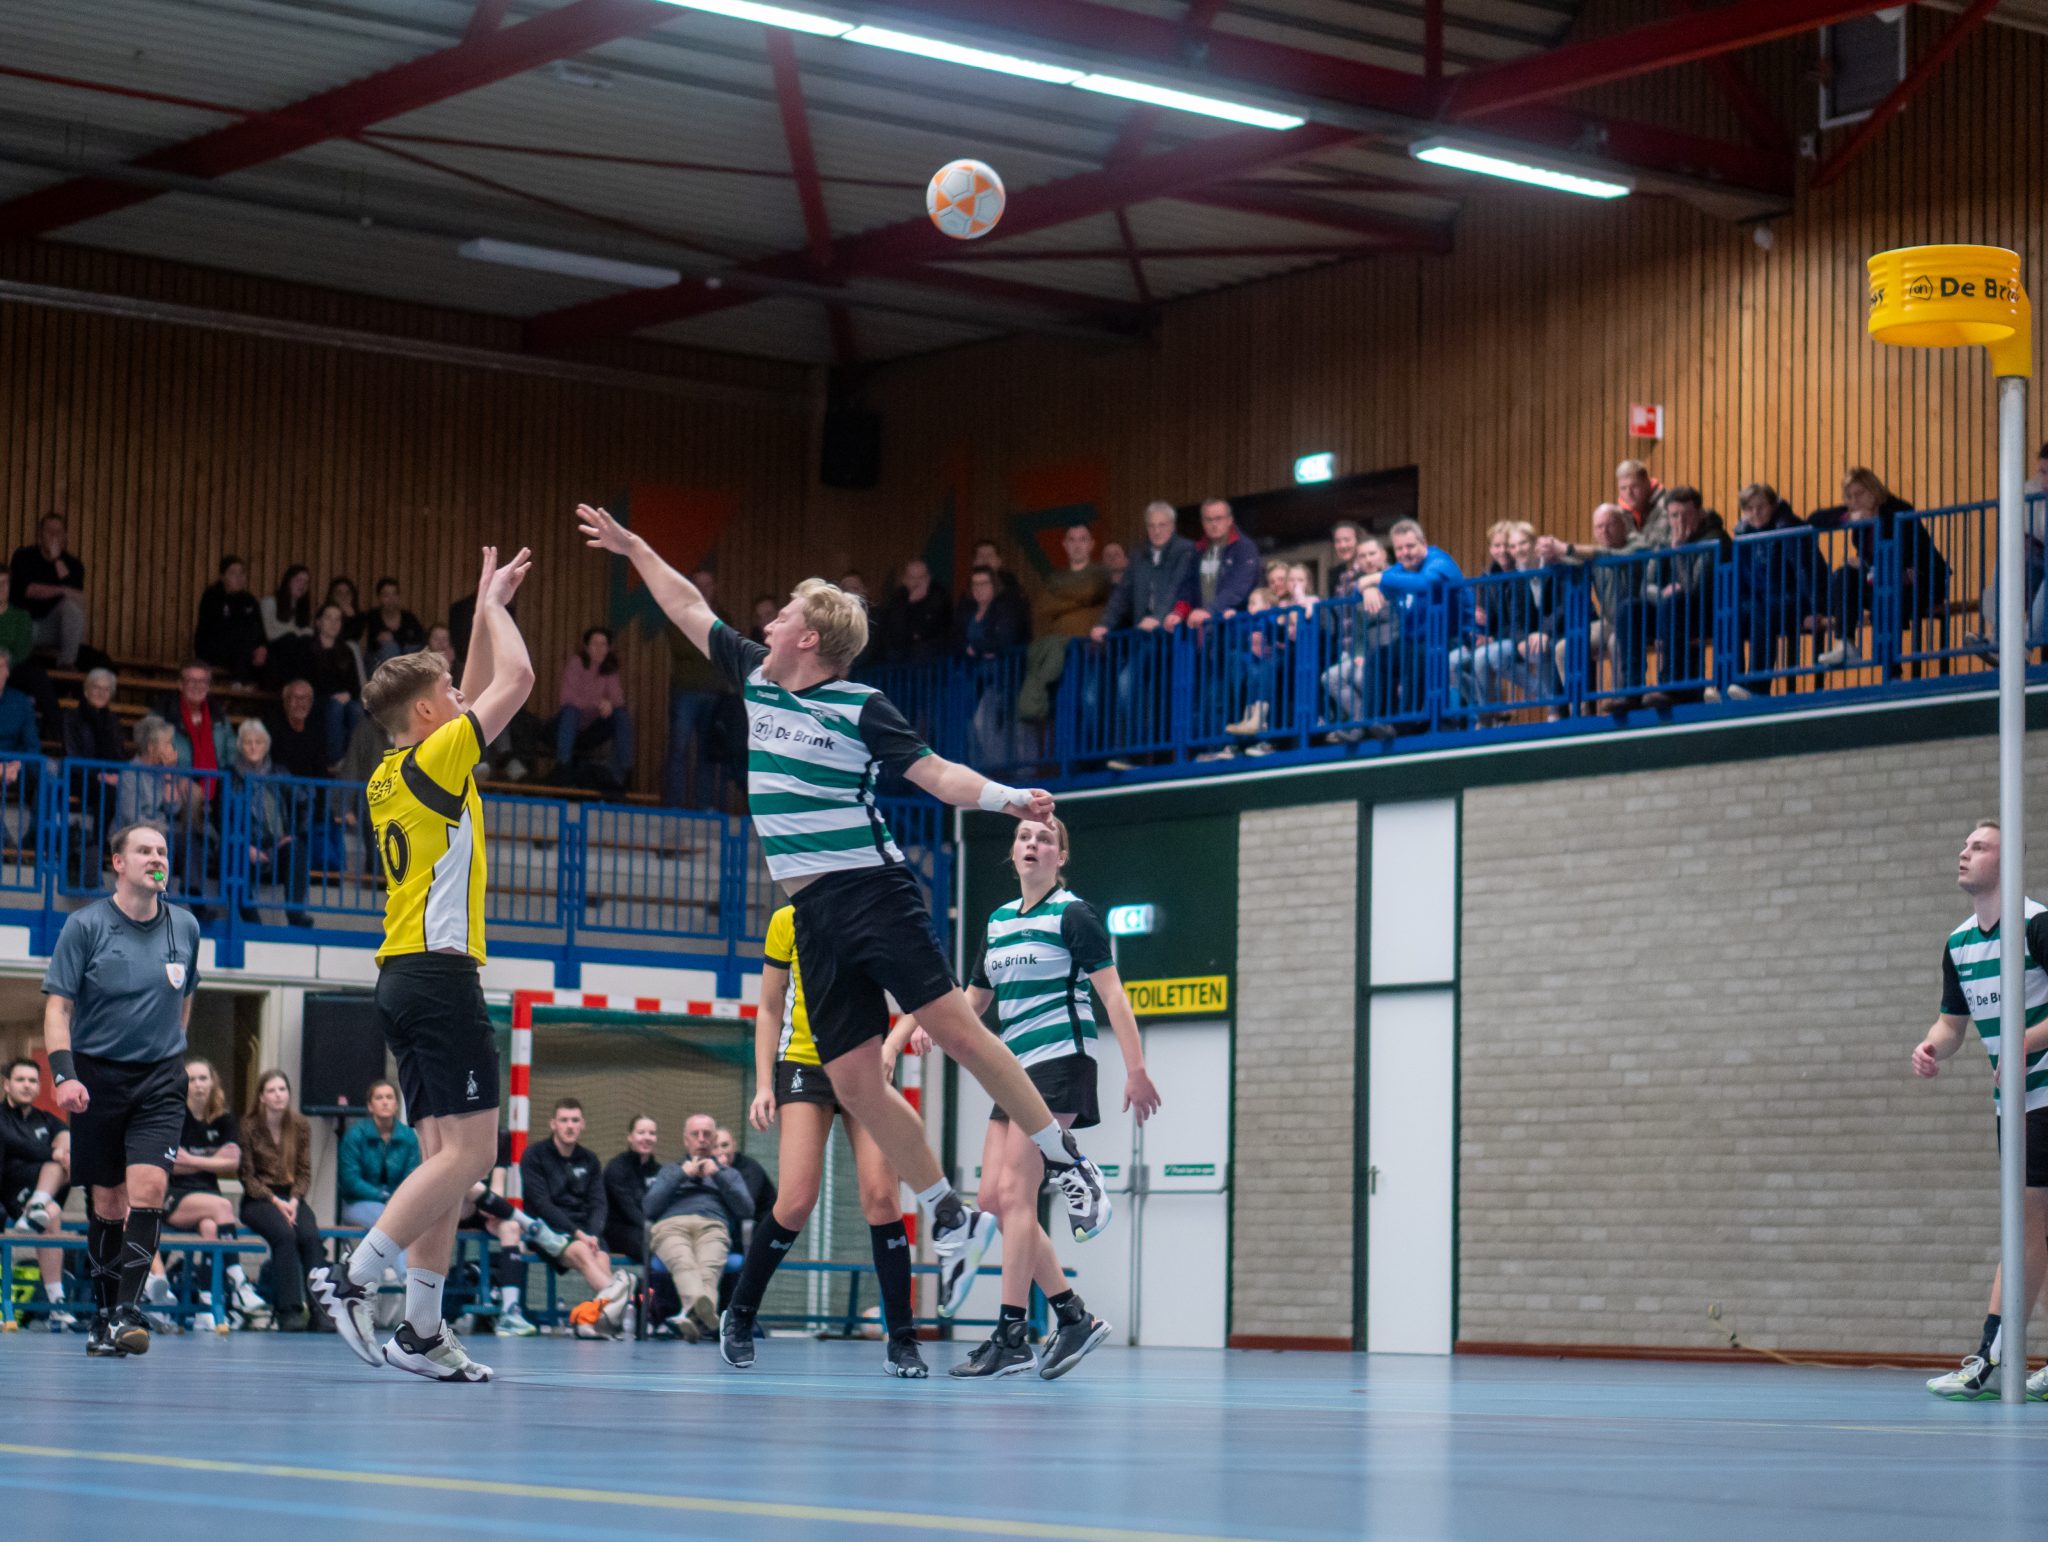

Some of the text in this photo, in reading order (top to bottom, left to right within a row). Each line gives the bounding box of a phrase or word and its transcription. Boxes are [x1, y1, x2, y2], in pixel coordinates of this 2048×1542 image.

[1940, 277, 1975, 298] De
[775, 726, 791, 740] De
[793, 730, 836, 751] Brink
[374, 818, 411, 889] 0
[992, 953, 1038, 971] De Brink
[1127, 981, 1222, 1009] TOILETTEN
[1976, 995, 1989, 1006] De
